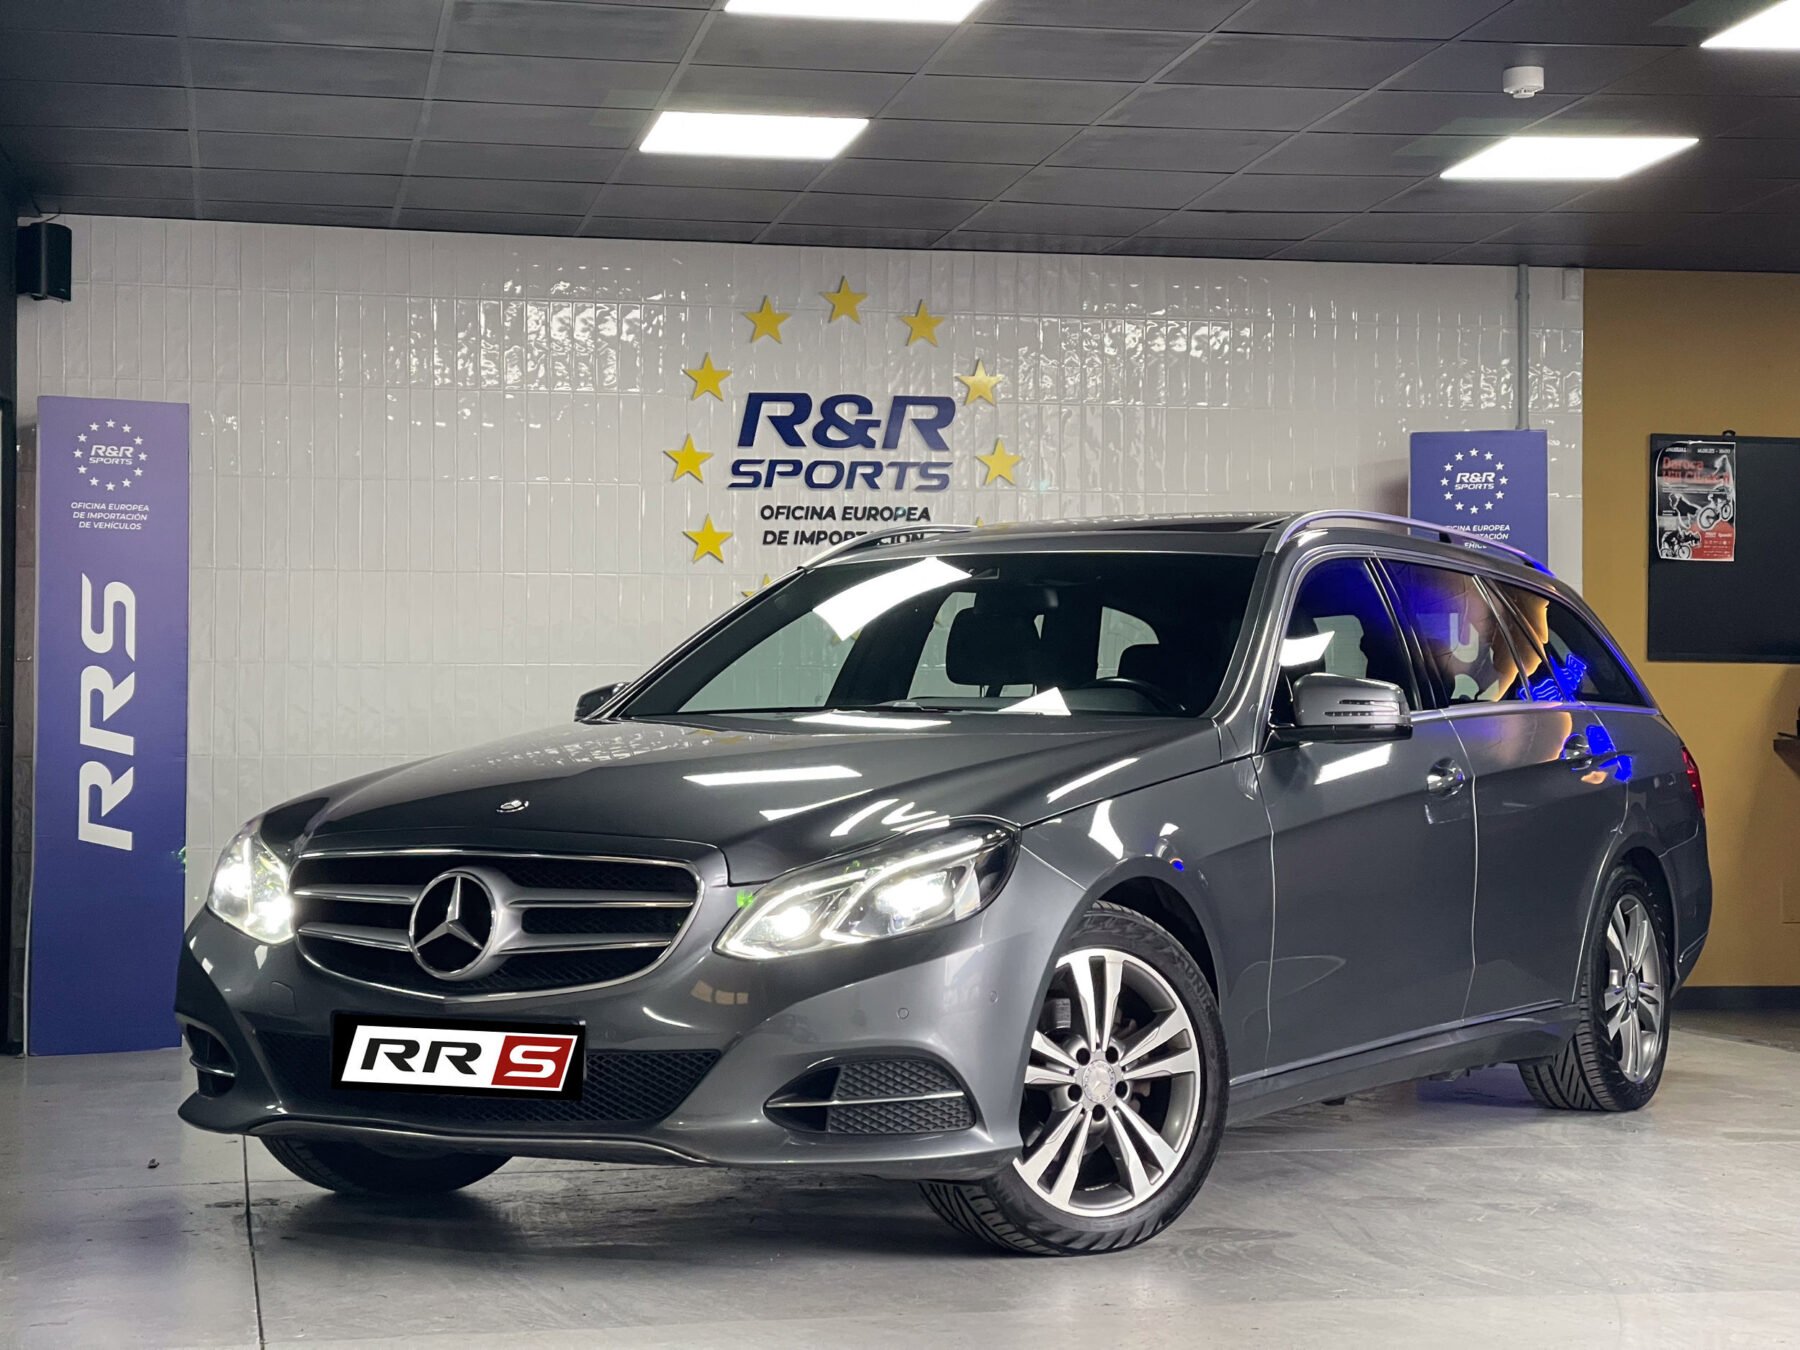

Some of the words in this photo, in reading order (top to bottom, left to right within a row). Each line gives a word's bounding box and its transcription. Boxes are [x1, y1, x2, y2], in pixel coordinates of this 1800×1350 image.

[737, 392, 957, 450] R&R
[91, 445, 134, 457] R&R
[727, 459, 953, 492] SPORTS
[1456, 472, 1496, 483] R&R
[70, 502, 107, 510] OFICINA
[108, 503, 149, 511] EUROPEA
[760, 505, 837, 521] OFICINA
[841, 506, 931, 522] EUROPEA
[72, 511, 86, 519] DE
[87, 512, 148, 521] IMPORTACIÓN
[78, 521, 92, 529] DE
[93, 521, 142, 530] VEHÍCULOS
[762, 530, 790, 545] DE
[78, 572, 136, 851] RRS
[361, 1037, 562, 1079] RRS
